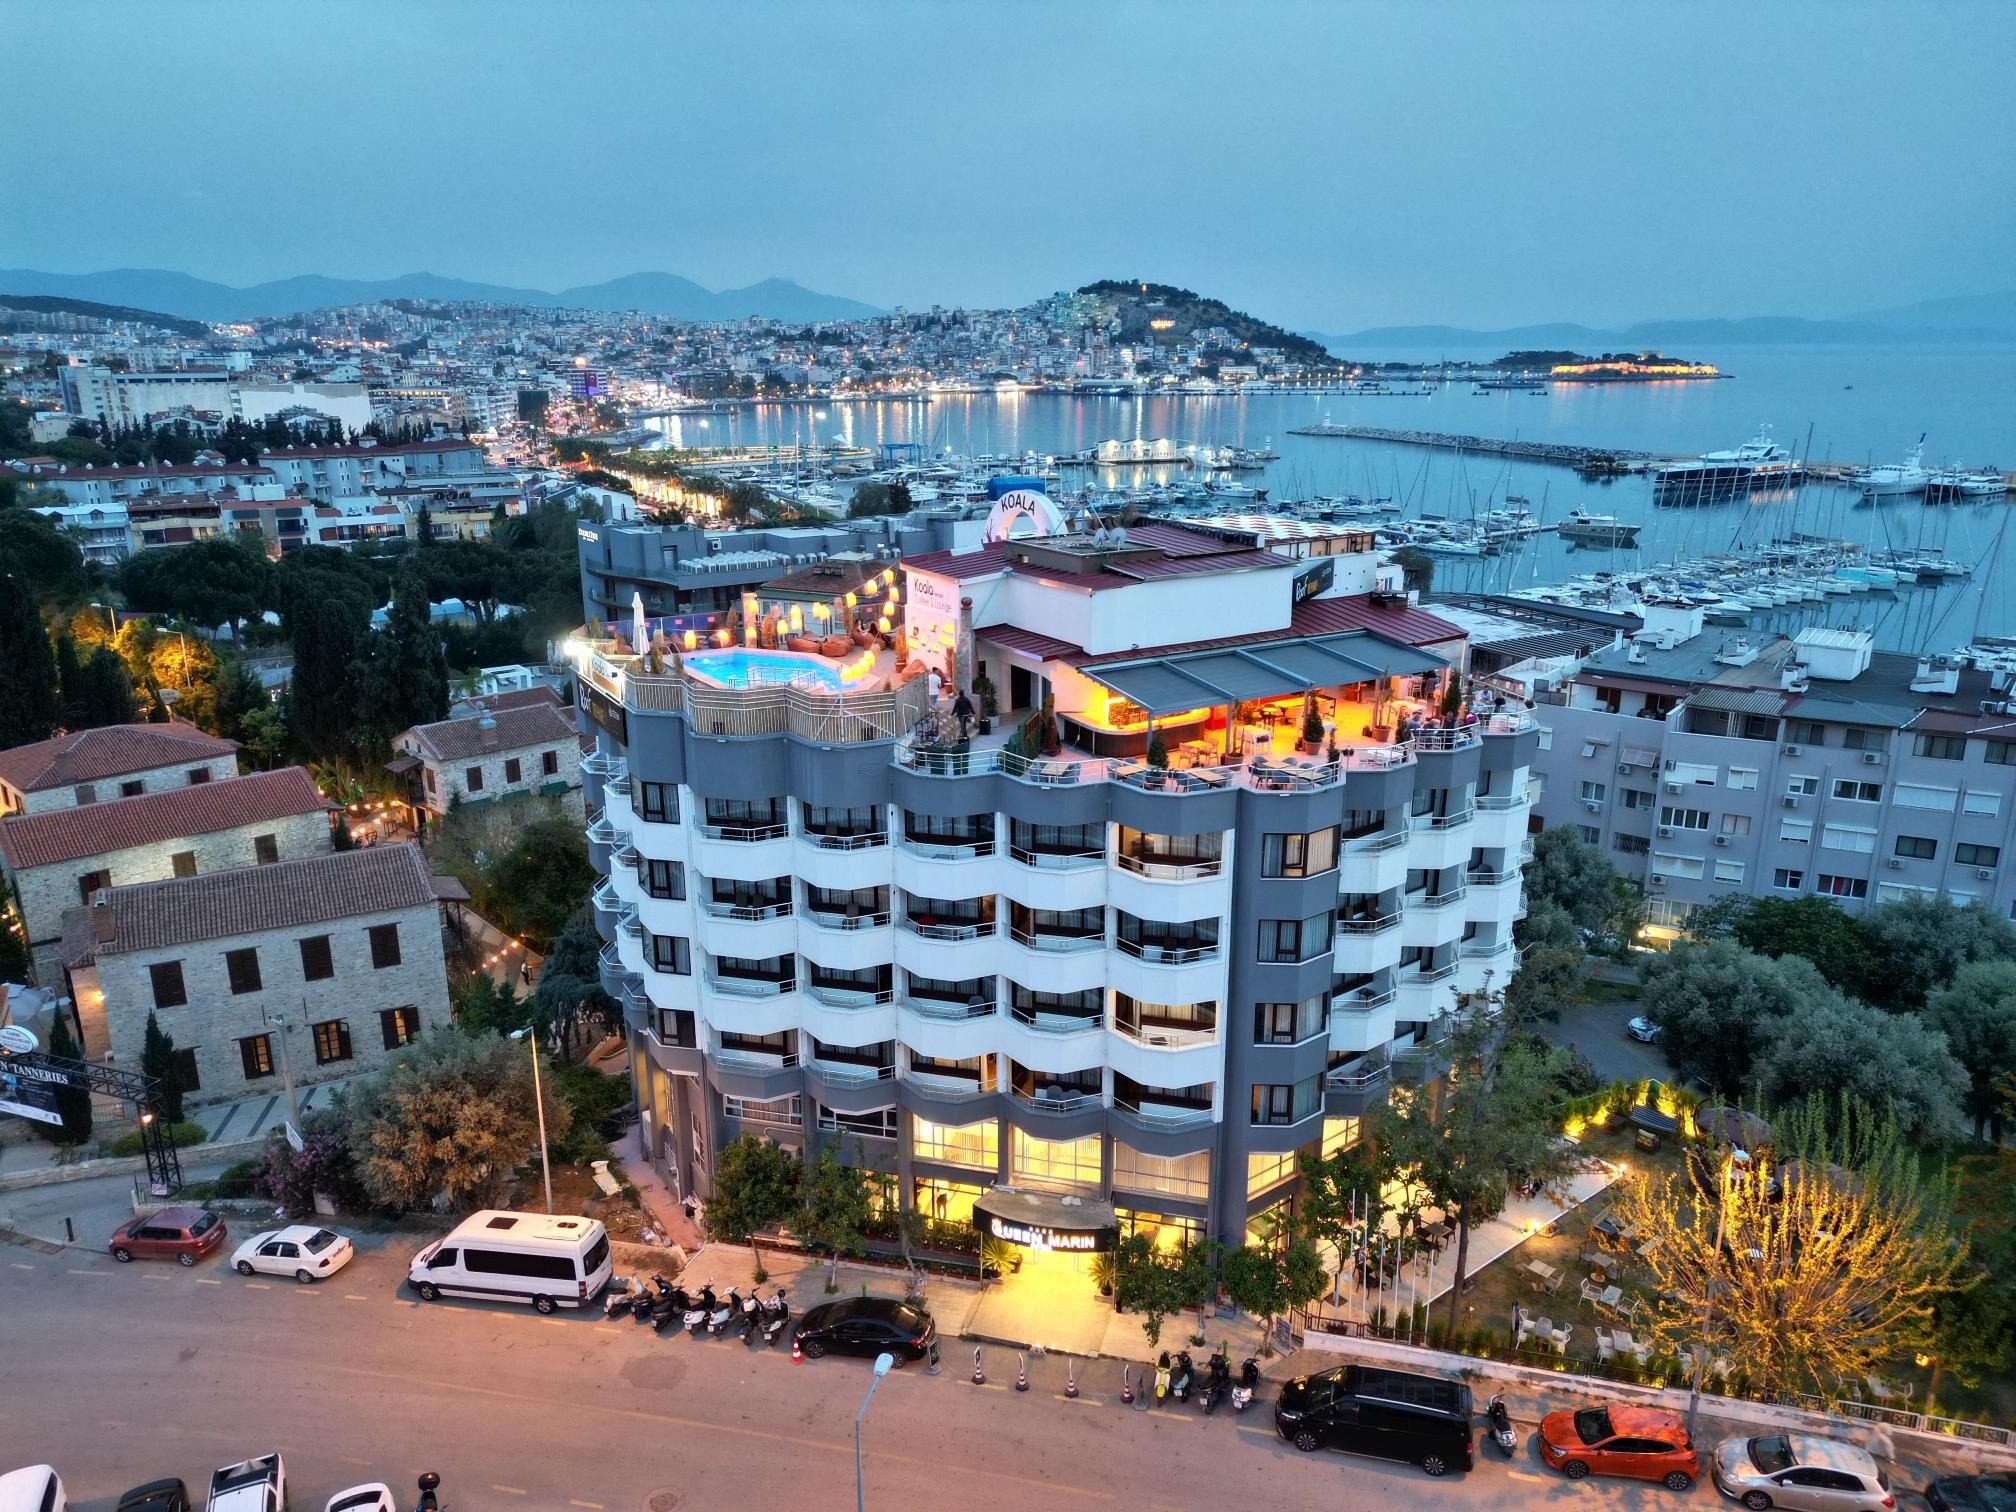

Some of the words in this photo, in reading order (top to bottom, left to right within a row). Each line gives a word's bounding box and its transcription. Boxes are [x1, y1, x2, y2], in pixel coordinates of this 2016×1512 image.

[1001, 494, 1035, 516] KOALA
[914, 578, 934, 596] Koala
[12, 1063, 69, 1085] TANNERIES
[991, 1219, 1043, 1244] QUEEN
[1048, 1235, 1096, 1248] MARIN
